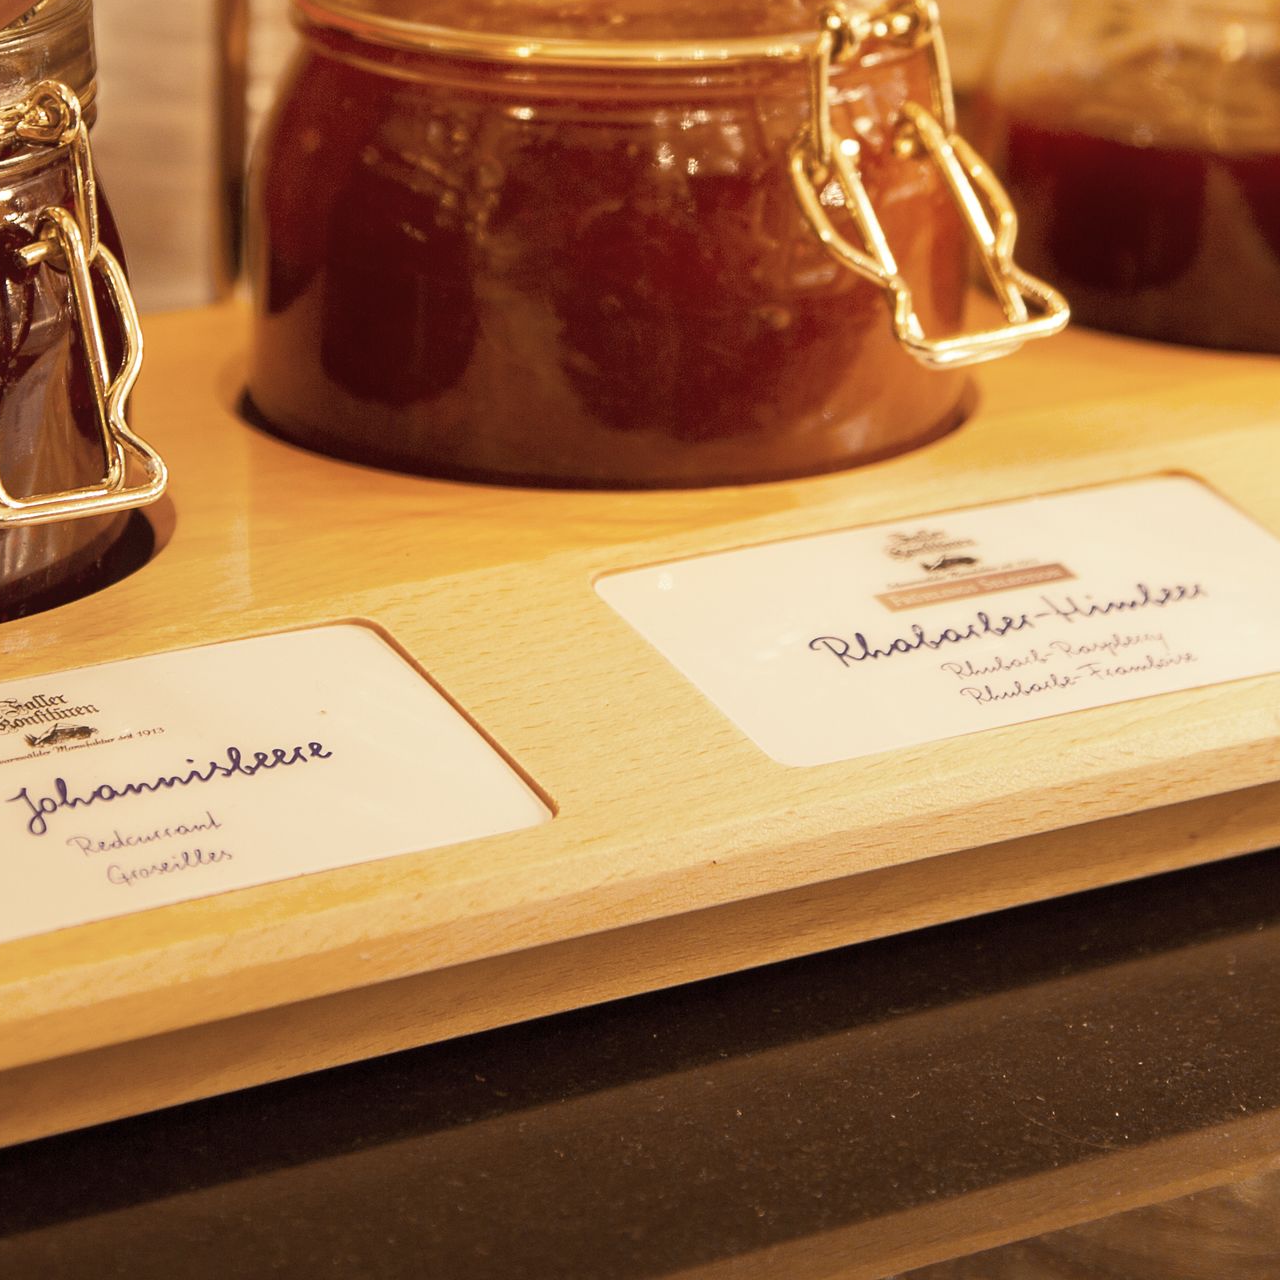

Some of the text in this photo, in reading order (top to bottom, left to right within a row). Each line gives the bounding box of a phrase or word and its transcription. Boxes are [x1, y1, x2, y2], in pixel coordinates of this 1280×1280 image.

[6, 739, 334, 837] Johannisbeere
[66, 810, 223, 857] Redcurrant
[107, 848, 233, 887] Groseilles
